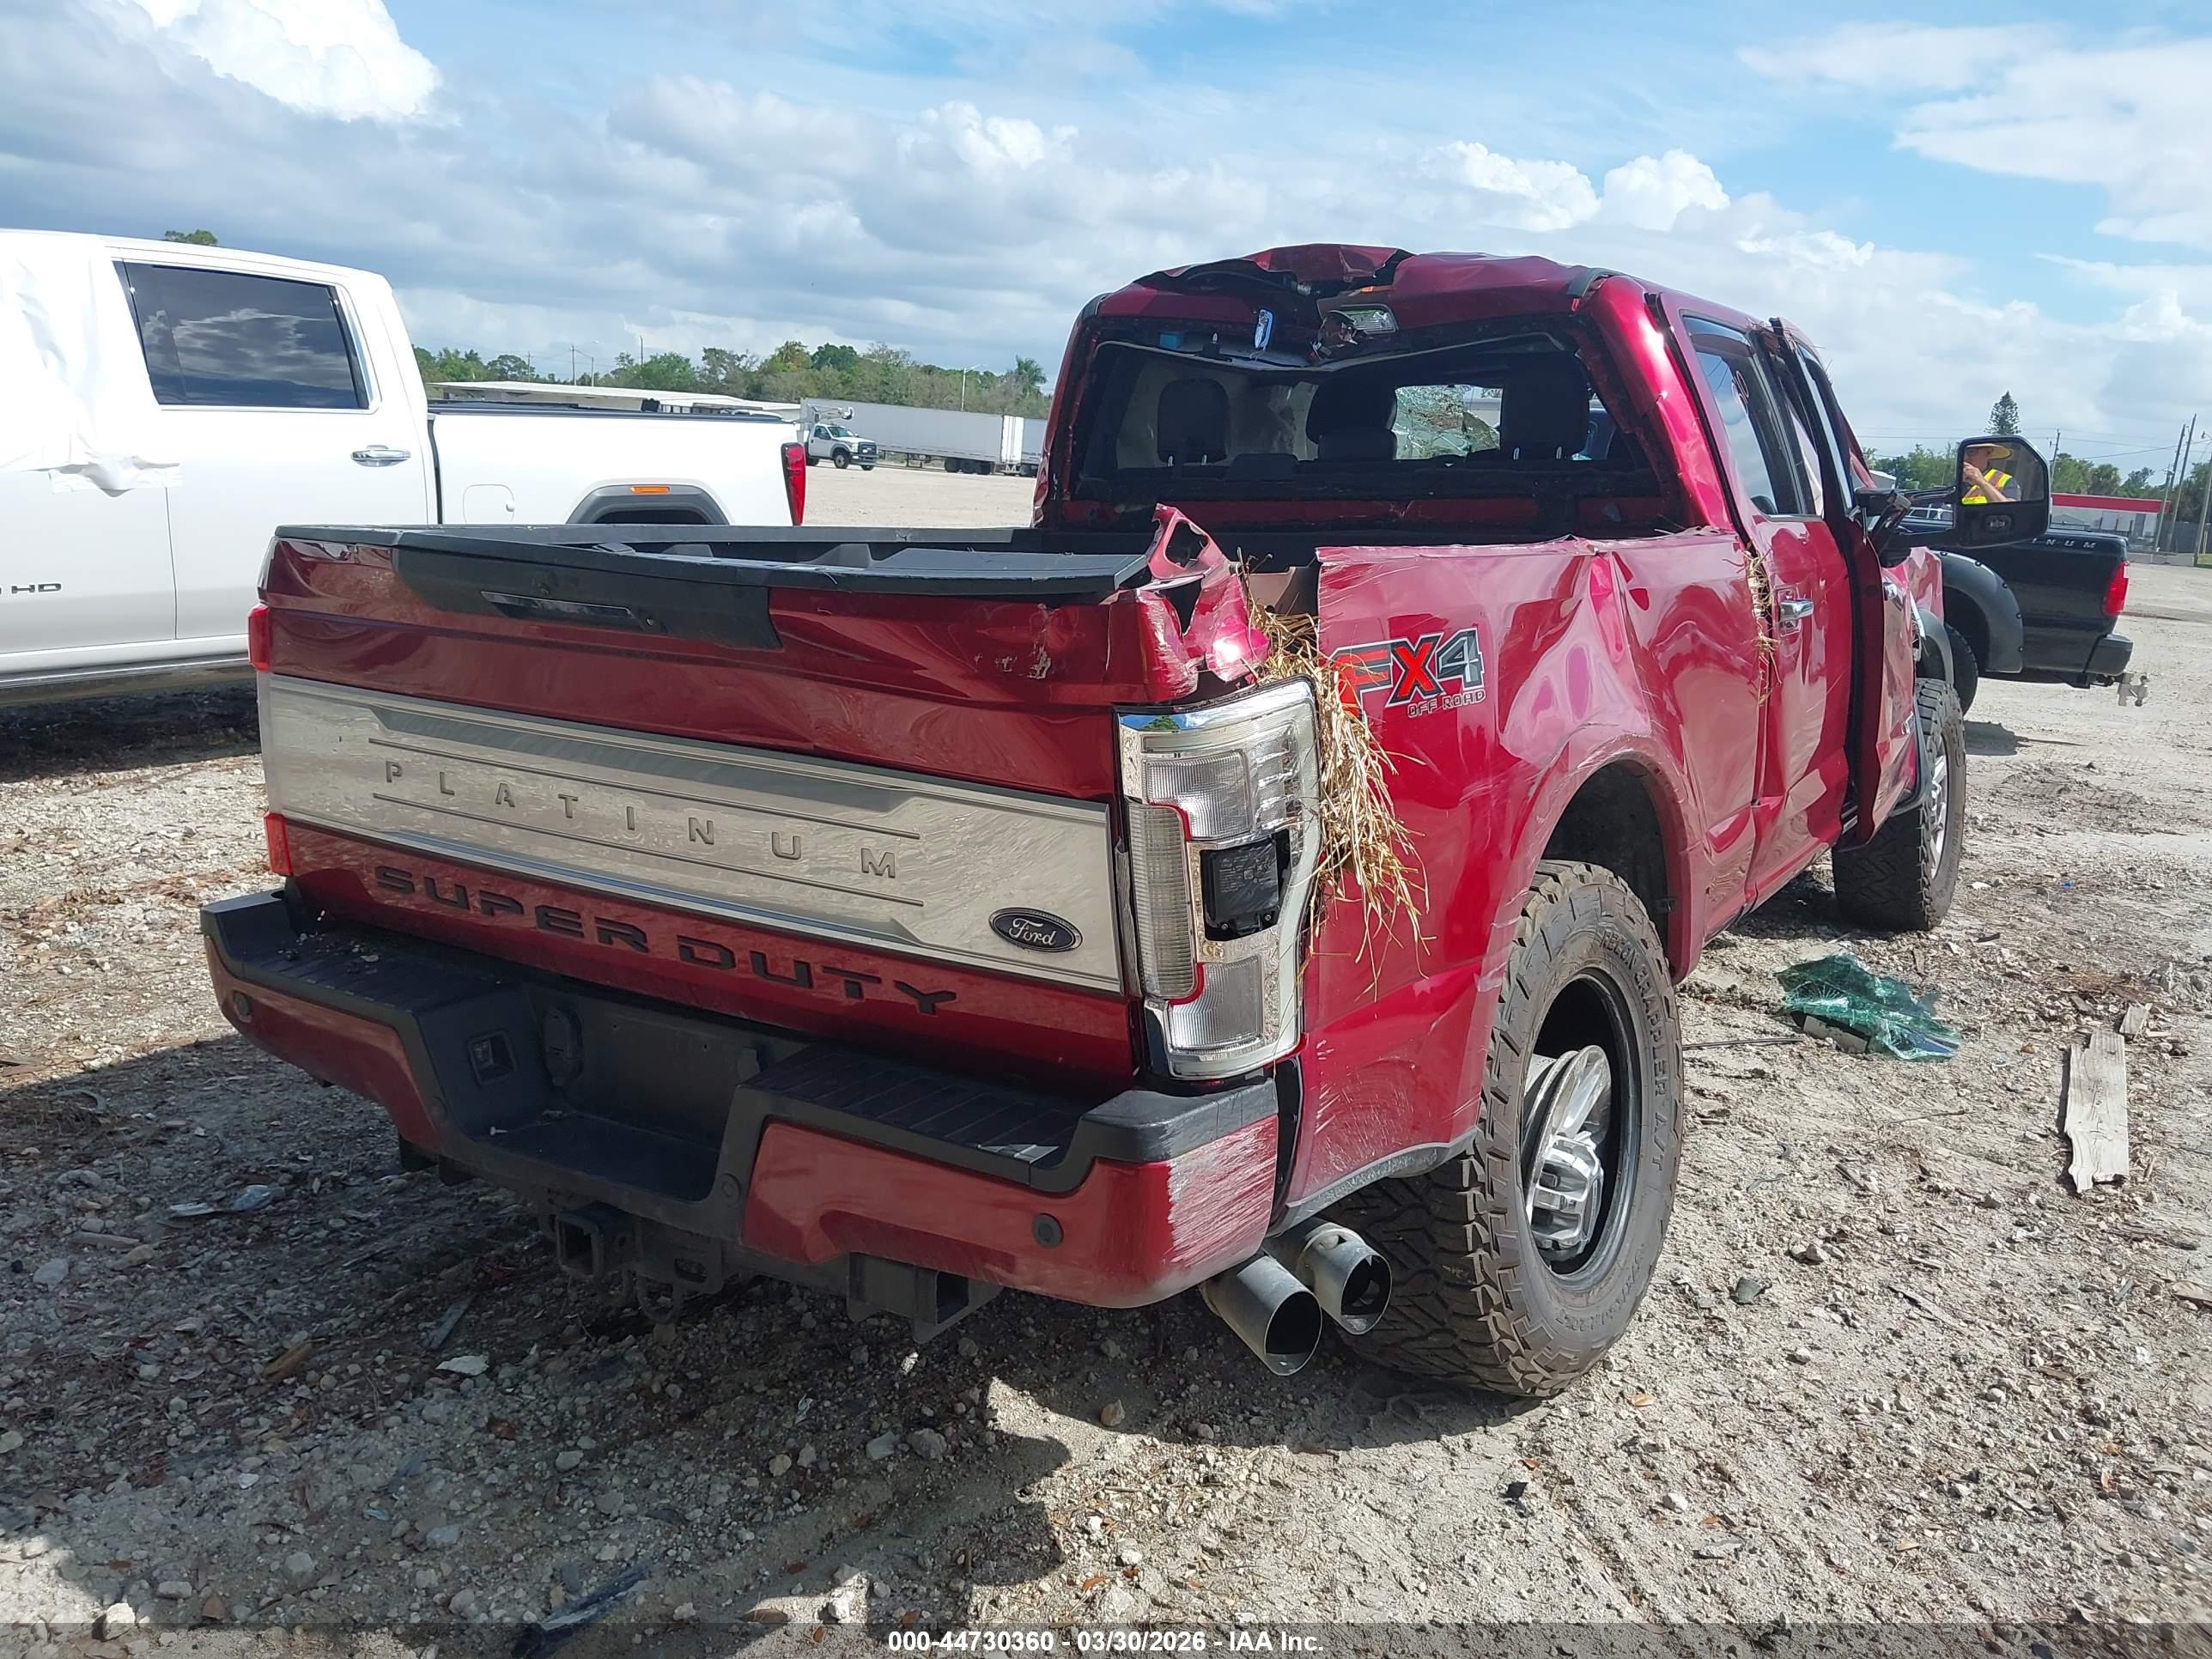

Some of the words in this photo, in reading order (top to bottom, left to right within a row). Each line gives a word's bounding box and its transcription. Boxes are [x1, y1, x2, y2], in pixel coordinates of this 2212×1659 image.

[11, 583, 62, 594] HD
[1328, 627, 1486, 721] FX4
[1407, 697, 1440, 719] OFF
[1442, 689, 1487, 711] ROAD
[383, 760, 898, 881] PLATINUM
[374, 864, 650, 956] SUPER
[678, 933, 959, 1017] DUTY
[1008, 916, 1058, 946] Ford
